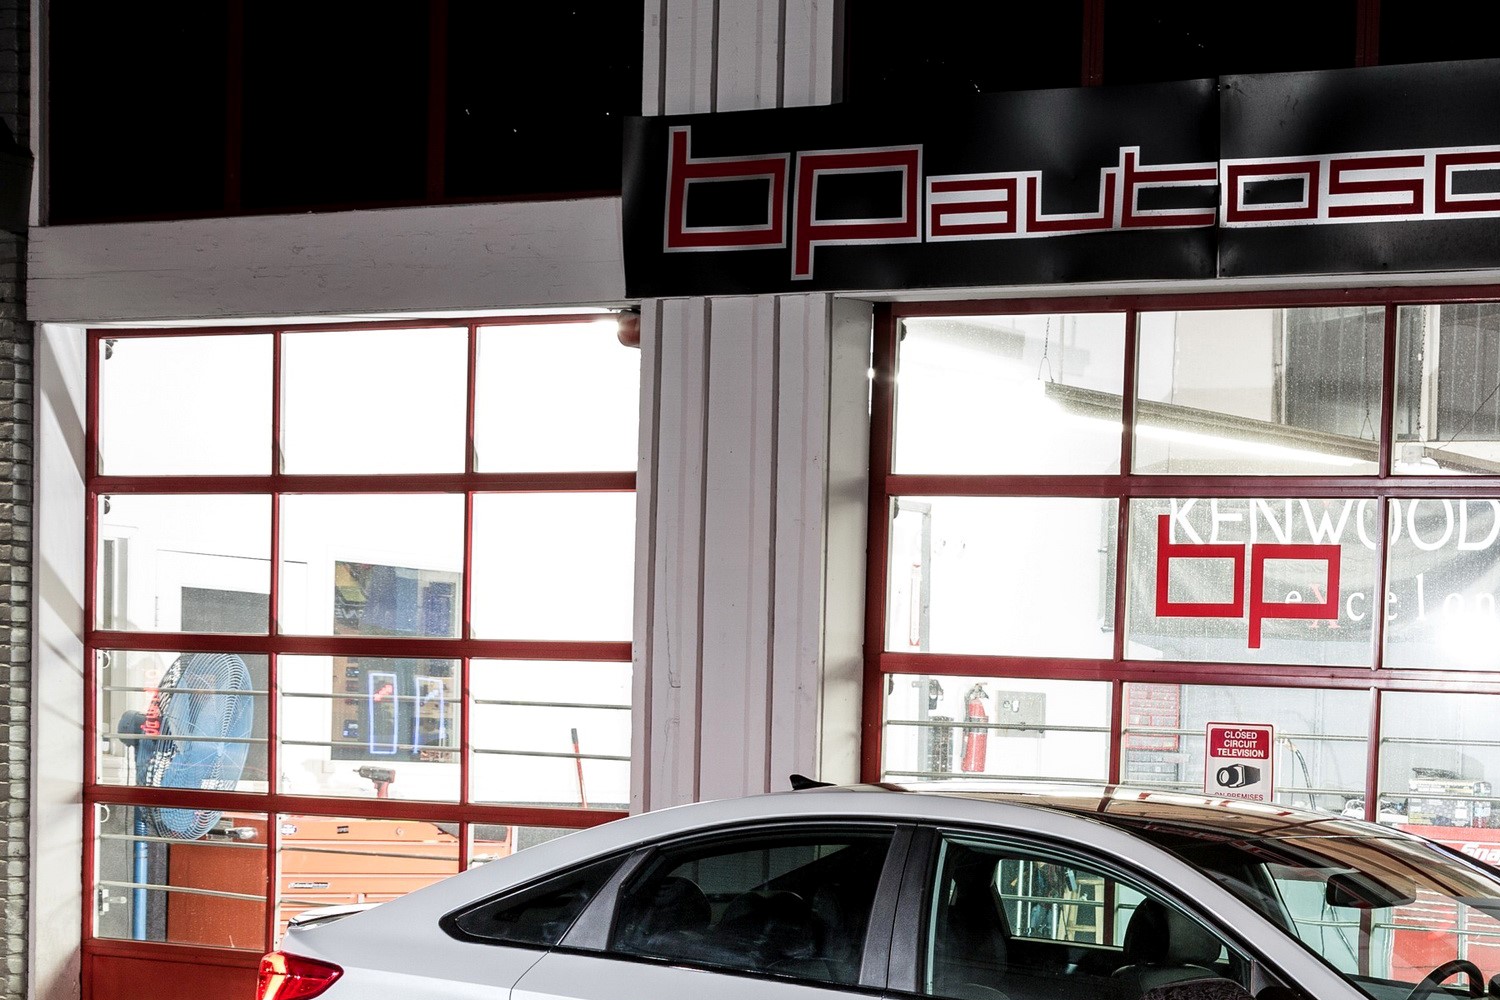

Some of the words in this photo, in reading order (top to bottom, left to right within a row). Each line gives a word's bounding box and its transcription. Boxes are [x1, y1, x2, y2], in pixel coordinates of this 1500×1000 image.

[1156, 514, 1342, 648] bp
[1224, 731, 1258, 740] CLOSED
[1223, 740, 1258, 748] CIRCUIT
[1217, 749, 1264, 758] TELEVISION
